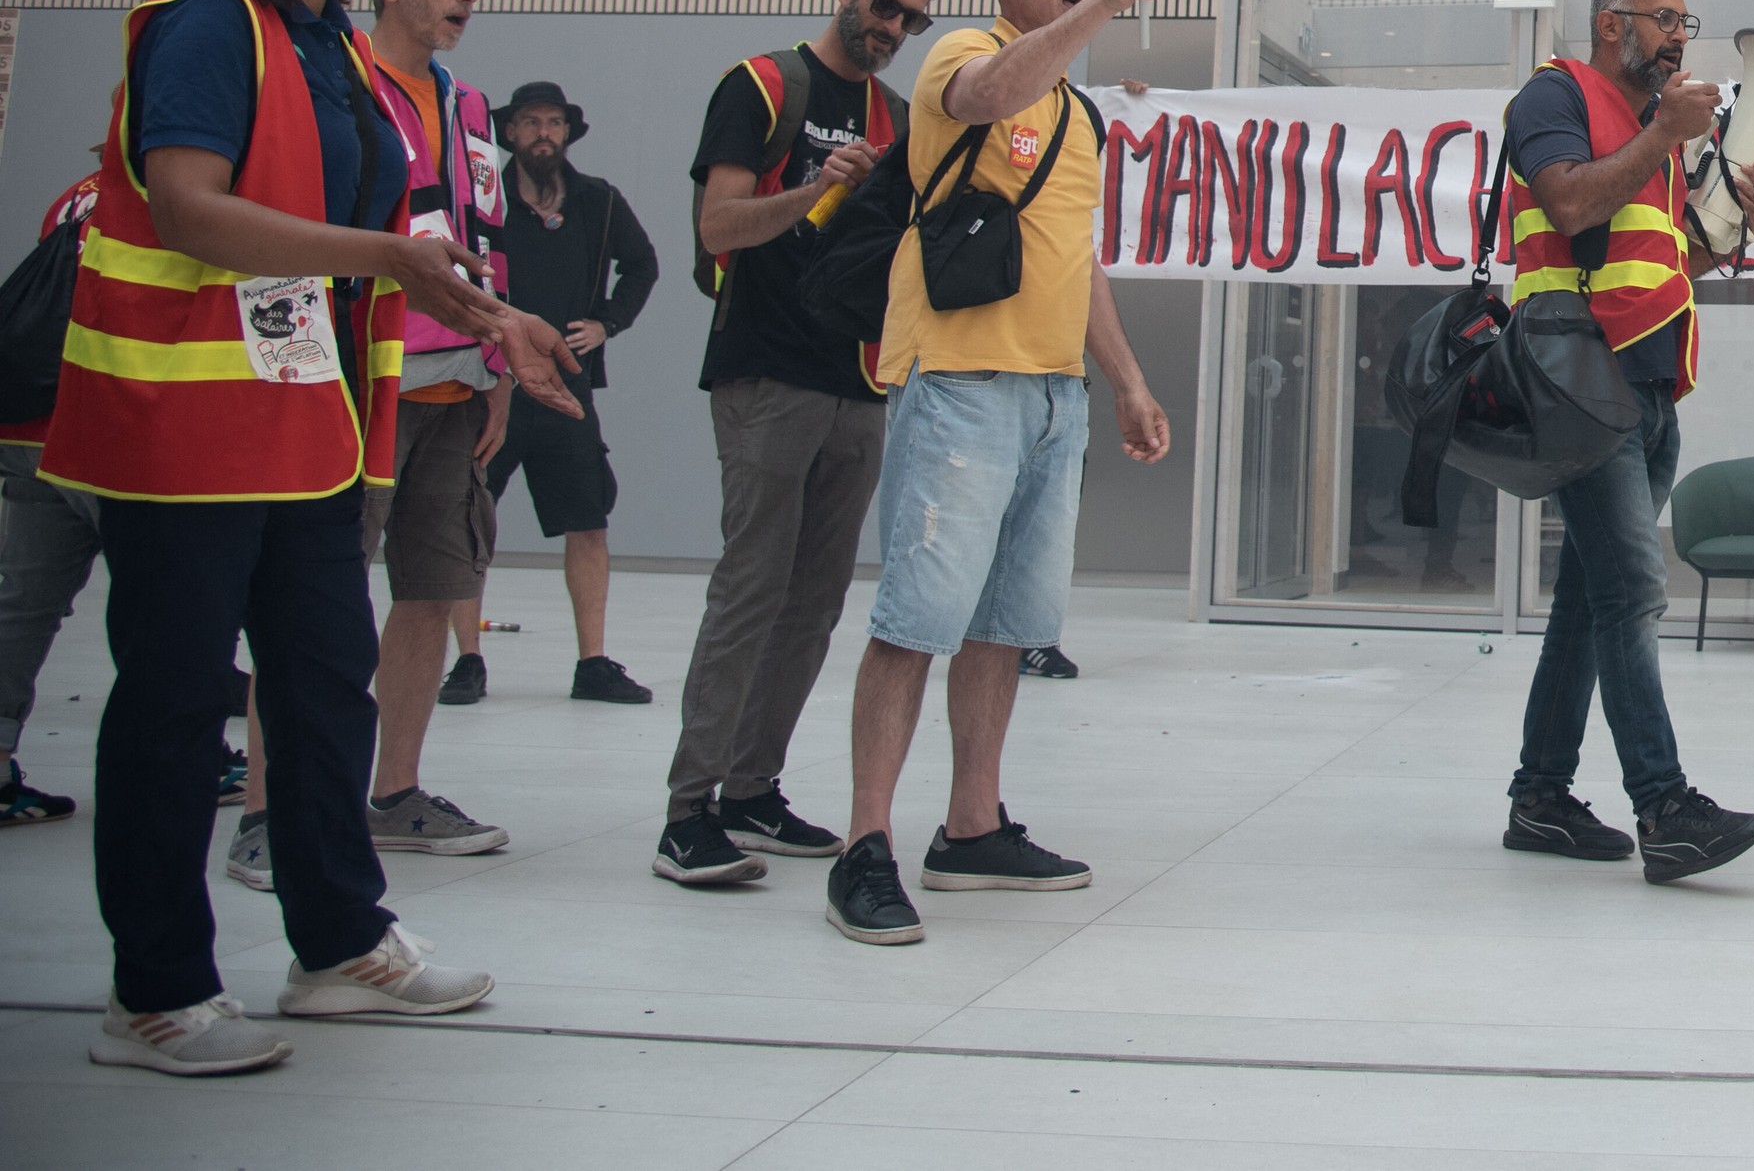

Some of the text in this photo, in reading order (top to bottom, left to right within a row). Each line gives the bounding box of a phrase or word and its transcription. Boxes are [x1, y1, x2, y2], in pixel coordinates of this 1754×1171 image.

[1012, 133, 1039, 156] cgt
[1013, 153, 1033, 165] RATP
[1101, 112, 1310, 273] MANU
[1317, 119, 1518, 272] LACH
[267, 310, 283, 318] des
[254, 318, 294, 332] salaires
